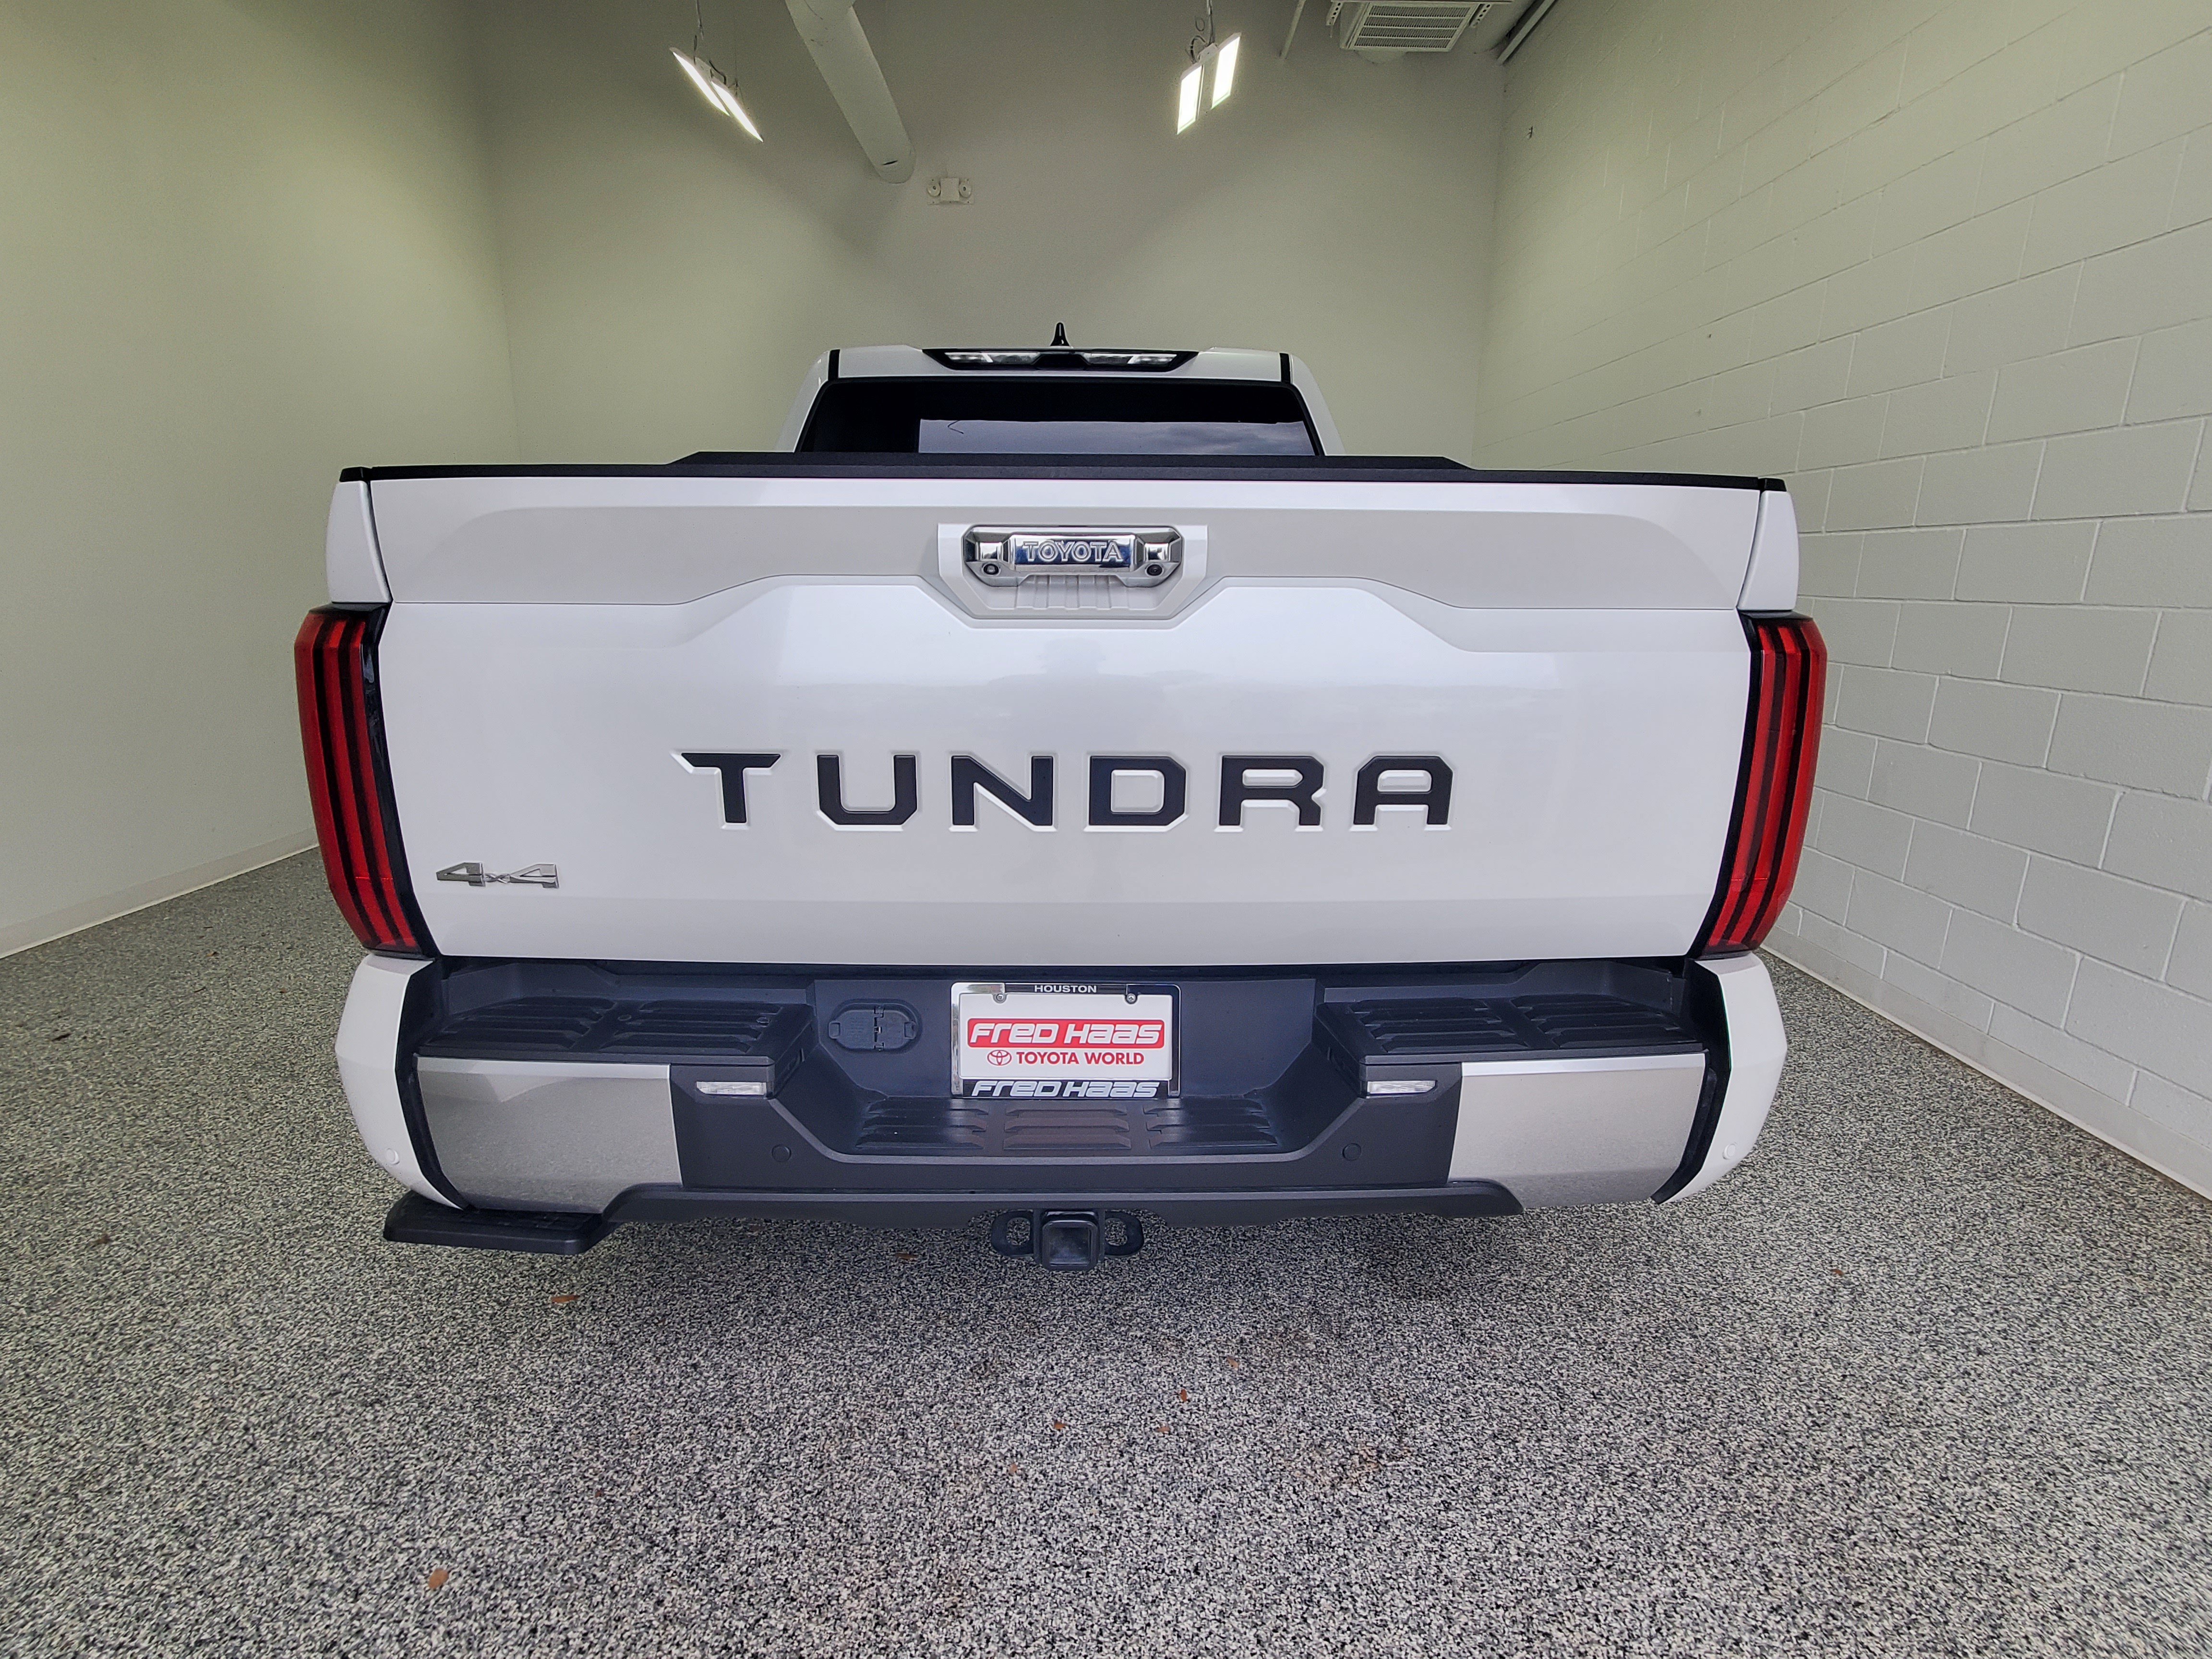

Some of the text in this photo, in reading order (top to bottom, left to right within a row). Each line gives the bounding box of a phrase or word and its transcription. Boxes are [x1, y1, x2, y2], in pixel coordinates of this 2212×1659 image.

[1023, 541, 1123, 563] TOYOTA
[673, 751, 1453, 830] TUNDRA
[1034, 985, 1097, 993] HOUSTON
[1016, 1051, 1144, 1065] TOYOTA WORLD
